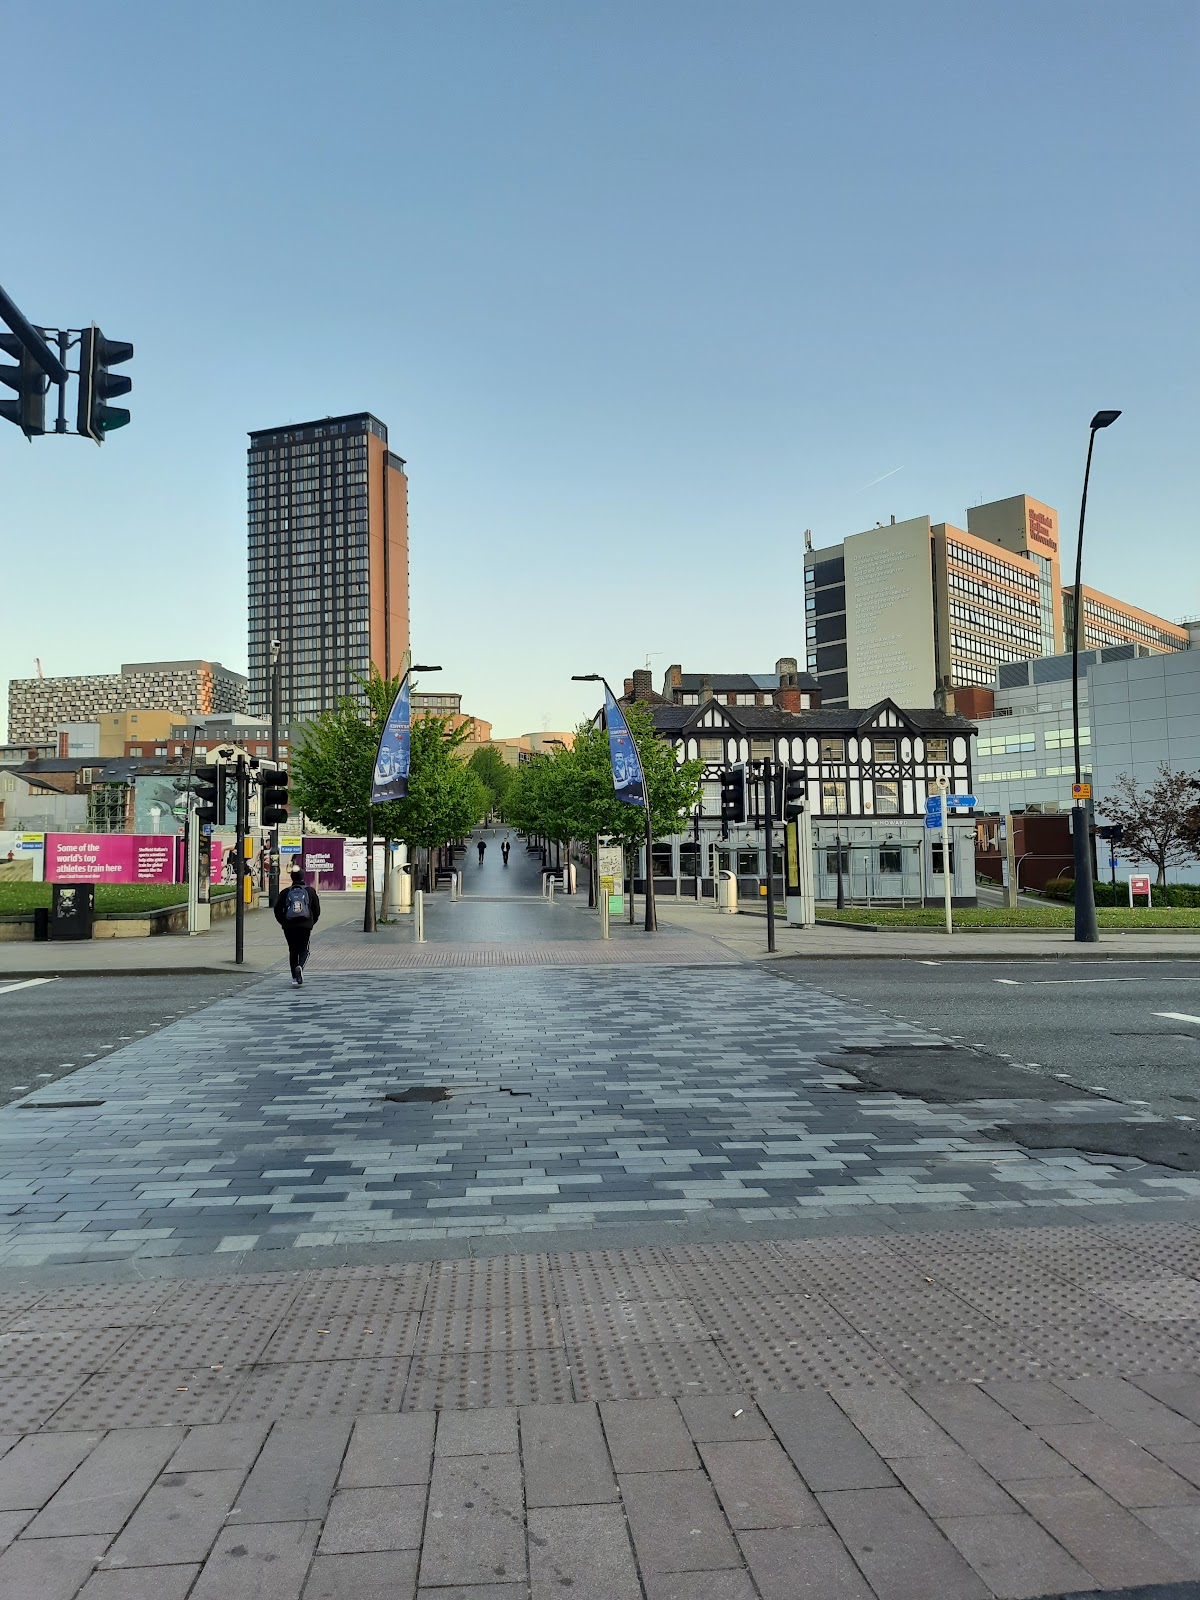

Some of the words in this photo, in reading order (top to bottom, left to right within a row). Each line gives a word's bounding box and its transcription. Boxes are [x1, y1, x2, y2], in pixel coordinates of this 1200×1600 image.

[1029, 509, 1052, 528] Sheffield
[1029, 519, 1049, 537] Hallam
[1030, 529, 1057, 553] University
[57, 844, 78, 852] Some
[78, 843, 86, 852] of
[87, 843, 100, 852] the
[57, 854, 83, 862] world's
[84, 854, 96, 863] top
[56, 864, 86, 872] athletes
[87, 864, 104, 872] train
